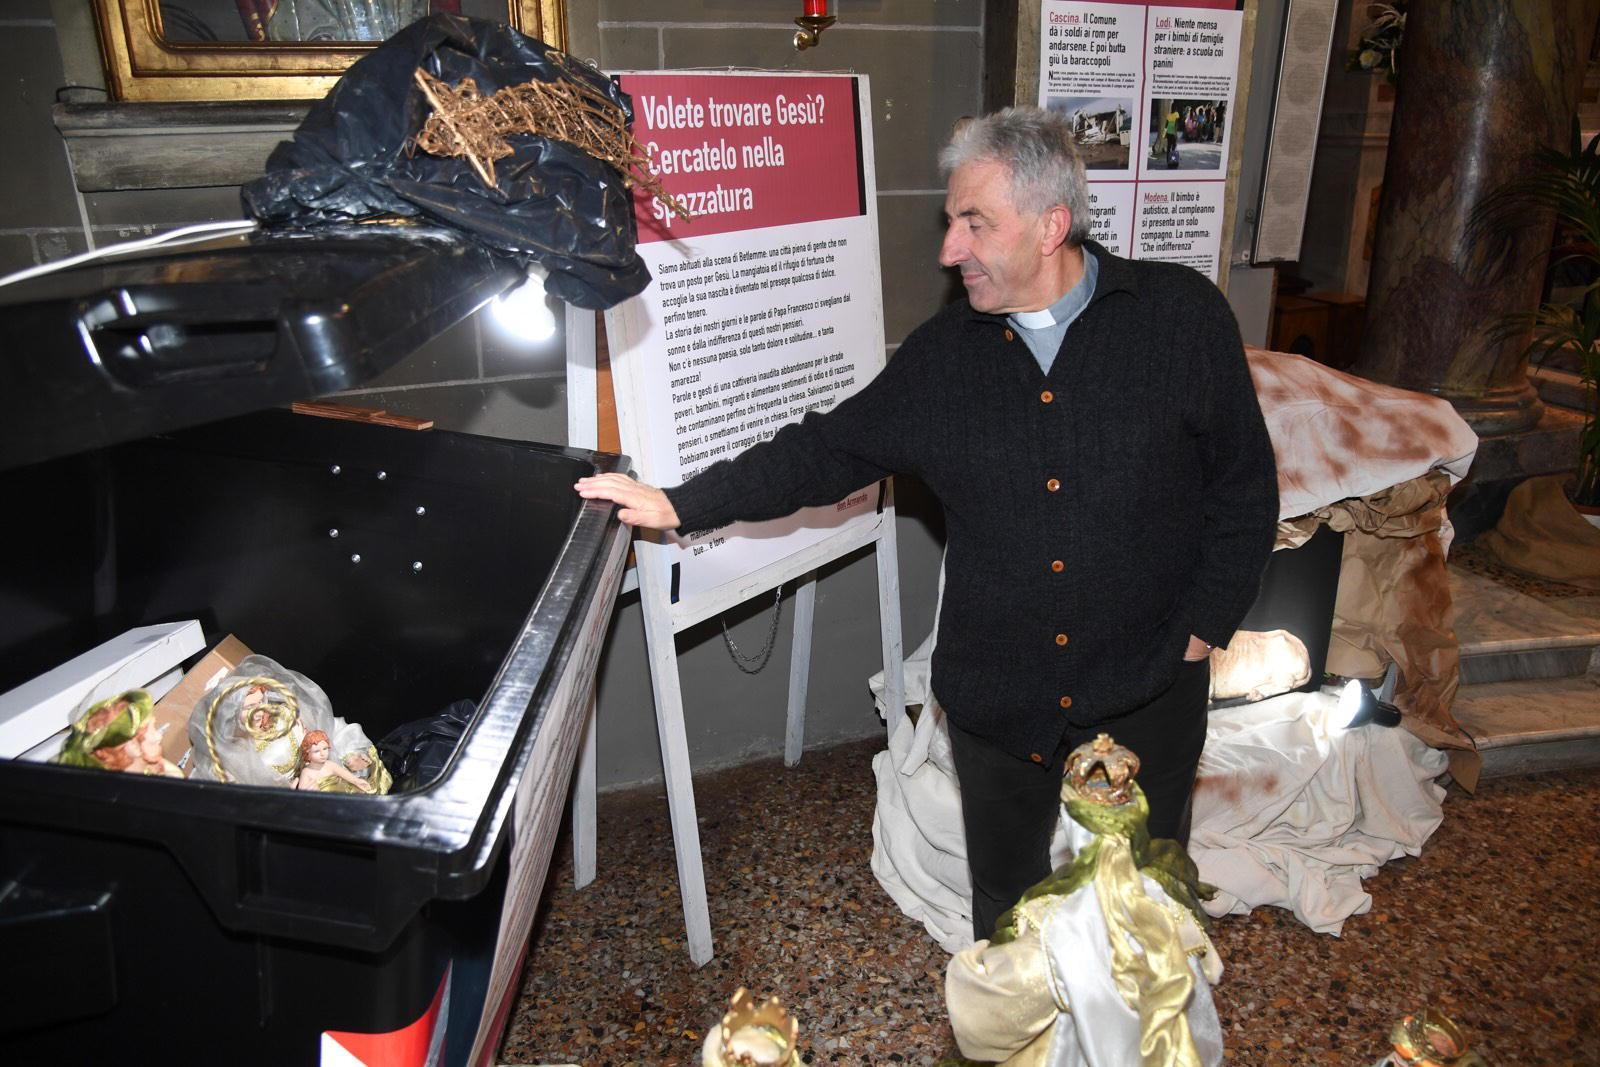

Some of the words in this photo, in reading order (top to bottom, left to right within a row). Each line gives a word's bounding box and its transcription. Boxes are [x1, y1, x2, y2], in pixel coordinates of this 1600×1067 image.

[1083, 13, 1088, 23] Il
[1089, 13, 1116, 25] Comune
[1174, 17, 1195, 28] Niente
[1196, 21, 1217, 30] mensa
[1049, 25, 1058, 36] dà
[1059, 25, 1062, 36] i
[1064, 26, 1082, 37] soldi
[1083, 26, 1090, 38] ai
[1091, 30, 1105, 38] rom
[1106, 30, 1119, 41] per
[1154, 32, 1167, 42] per
[1168, 30, 1170, 41] i
[1172, 31, 1190, 42] bimbi
[1191, 32, 1198, 42] di
[1199, 32, 1224, 45] famiglie
[1089, 40, 1095, 52] E
[1095, 41, 1107, 54] poi
[1108, 42, 1126, 53] butta
[1153, 44, 1184, 55] straniere:
[1186, 47, 1191, 55] a
[1192, 46, 1213, 56] scuola
[1214, 46, 1223, 57] coi
[1048, 53, 1060, 67] giù
[1061, 53, 1068, 65] la
[1069, 54, 1110, 68] baraccopoli
[1152, 58, 1173, 69] panini
[641, 95, 703, 129] Volete
[709, 98, 771, 126] trovare
[776, 94, 824, 124] Gesù?
[646, 139, 736, 175] Cercatelo
[742, 136, 784, 168] nella
[1170, 192, 1174, 201] Il
[1176, 192, 1194, 201] bimbo
[1195, 191, 1200, 201] è
[652, 184, 752, 227] spazzatura
[1171, 204, 1177, 214] al
[1178, 205, 1215, 215] compleanno
[1104, 218, 1111, 228] di
[1141, 217, 1147, 227] si
[1148, 217, 1175, 229] presenta
[1176, 218, 1184, 226] un
[1185, 217, 1198, 226] solo
[1111, 231, 1118, 241] in
[1175, 229, 1183, 238] La
[658, 263, 678, 274] Siamo
[679, 258, 701, 271] abituati
[702, 256, 713, 267] alla
[713, 256, 731, 266] scena
[732, 252, 738, 262] di
[768, 249, 779, 257] una
[779, 245, 791, 255] città
[791, 244, 806, 256] piena
[806, 241, 812, 251] di
[812, 240, 827, 252] gente
[827, 238, 837, 248] che
[659, 281, 676, 291] trova
[677, 279, 685, 288] un
[686, 275, 702, 289] posto
[703, 274, 714, 286] per
[731, 269, 739, 279] La
[740, 263, 770, 278] mangiatoia
[770, 262, 778, 272] ed
[778, 261, 782, 270] il
[782, 259, 800, 271] rifugio
[800, 257, 806, 267] di
[806, 256, 824, 266] fortuna
[825, 253, 834, 263] che
[662, 293, 688, 308] accoglie
[688, 292, 695, 302] la
[695, 292, 707, 301] sua
[707, 286, 729, 298] nascita
[734, 282, 759, 294] diventato
[760, 278, 769, 289] nel
[769, 277, 790, 289] presepe
[791, 272, 814, 285] qualcosa
[815, 269, 820, 279] di
[663, 311, 686, 326] perfino
[665, 330, 673, 340] La
[674, 326, 692, 338] storia
[692, 323, 702, 334] dei
[703, 319, 720, 332] nostri
[721, 315, 738, 331] giorni
[742, 313, 748, 323] le
[749, 310, 766, 324] parole
[767, 308, 773, 318] di
[773, 307, 786, 318] Papa
[787, 302, 813, 313] Francesco
[814, 298, 819, 308] ci
[819, 296, 842, 308] svegliano
[667, 345, 686, 356] sonno
[691, 338, 706, 350] dalla
[707, 333, 741, 346] indifferenza
[741, 328, 747, 339] di
[748, 325, 765, 340] questi
[765, 321, 781, 333] nostri
[668, 362, 681, 372] Non
[692, 354, 717, 366] nessuna
[739, 344, 751, 355] solo
[751, 341, 766, 352] tanto
[766, 338, 783, 349] dolore
[821, 326, 834, 335] tanta
[672, 390, 691, 403] Parole
[697, 384, 712, 400] gesti
[713, 382, 719, 393] di
[720, 382, 731, 391] una
[731, 373, 757, 388] cattiveria
[757, 368, 780, 381] inaudita
[814, 357, 822, 368] per
[823, 354, 828, 364] le
[829, 351, 843, 362] strade
[679, 450, 708, 466] Dobbiamo
[709, 445, 725, 456] avere
[726, 441, 731, 450] il
[731, 436, 756, 449] coraggio
[756, 431, 762, 441] di
